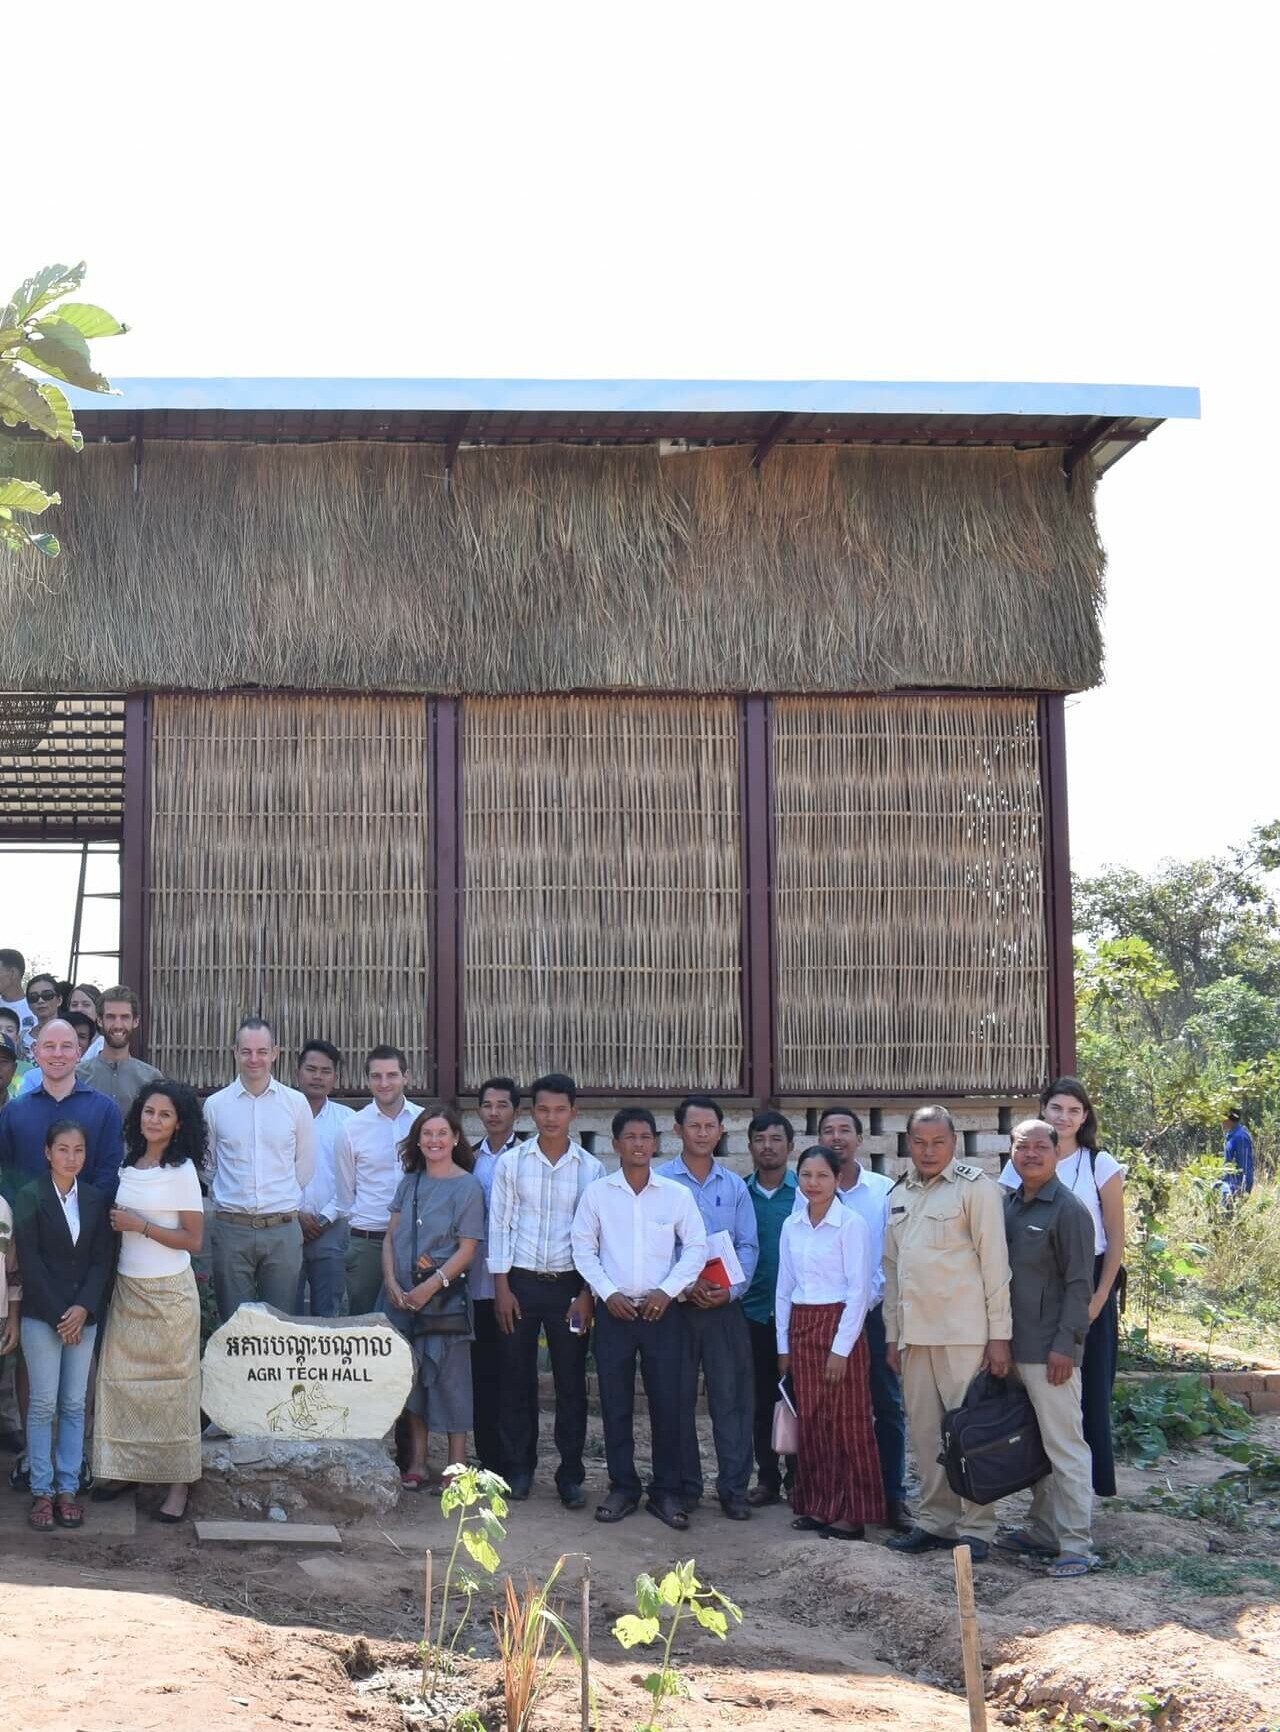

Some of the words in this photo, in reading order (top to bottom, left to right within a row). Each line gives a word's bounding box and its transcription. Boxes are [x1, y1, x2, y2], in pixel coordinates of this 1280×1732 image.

[247, 1368, 282, 1381] AGRI
[286, 1367, 328, 1381] TECH
[332, 1368, 373, 1382] HALL
